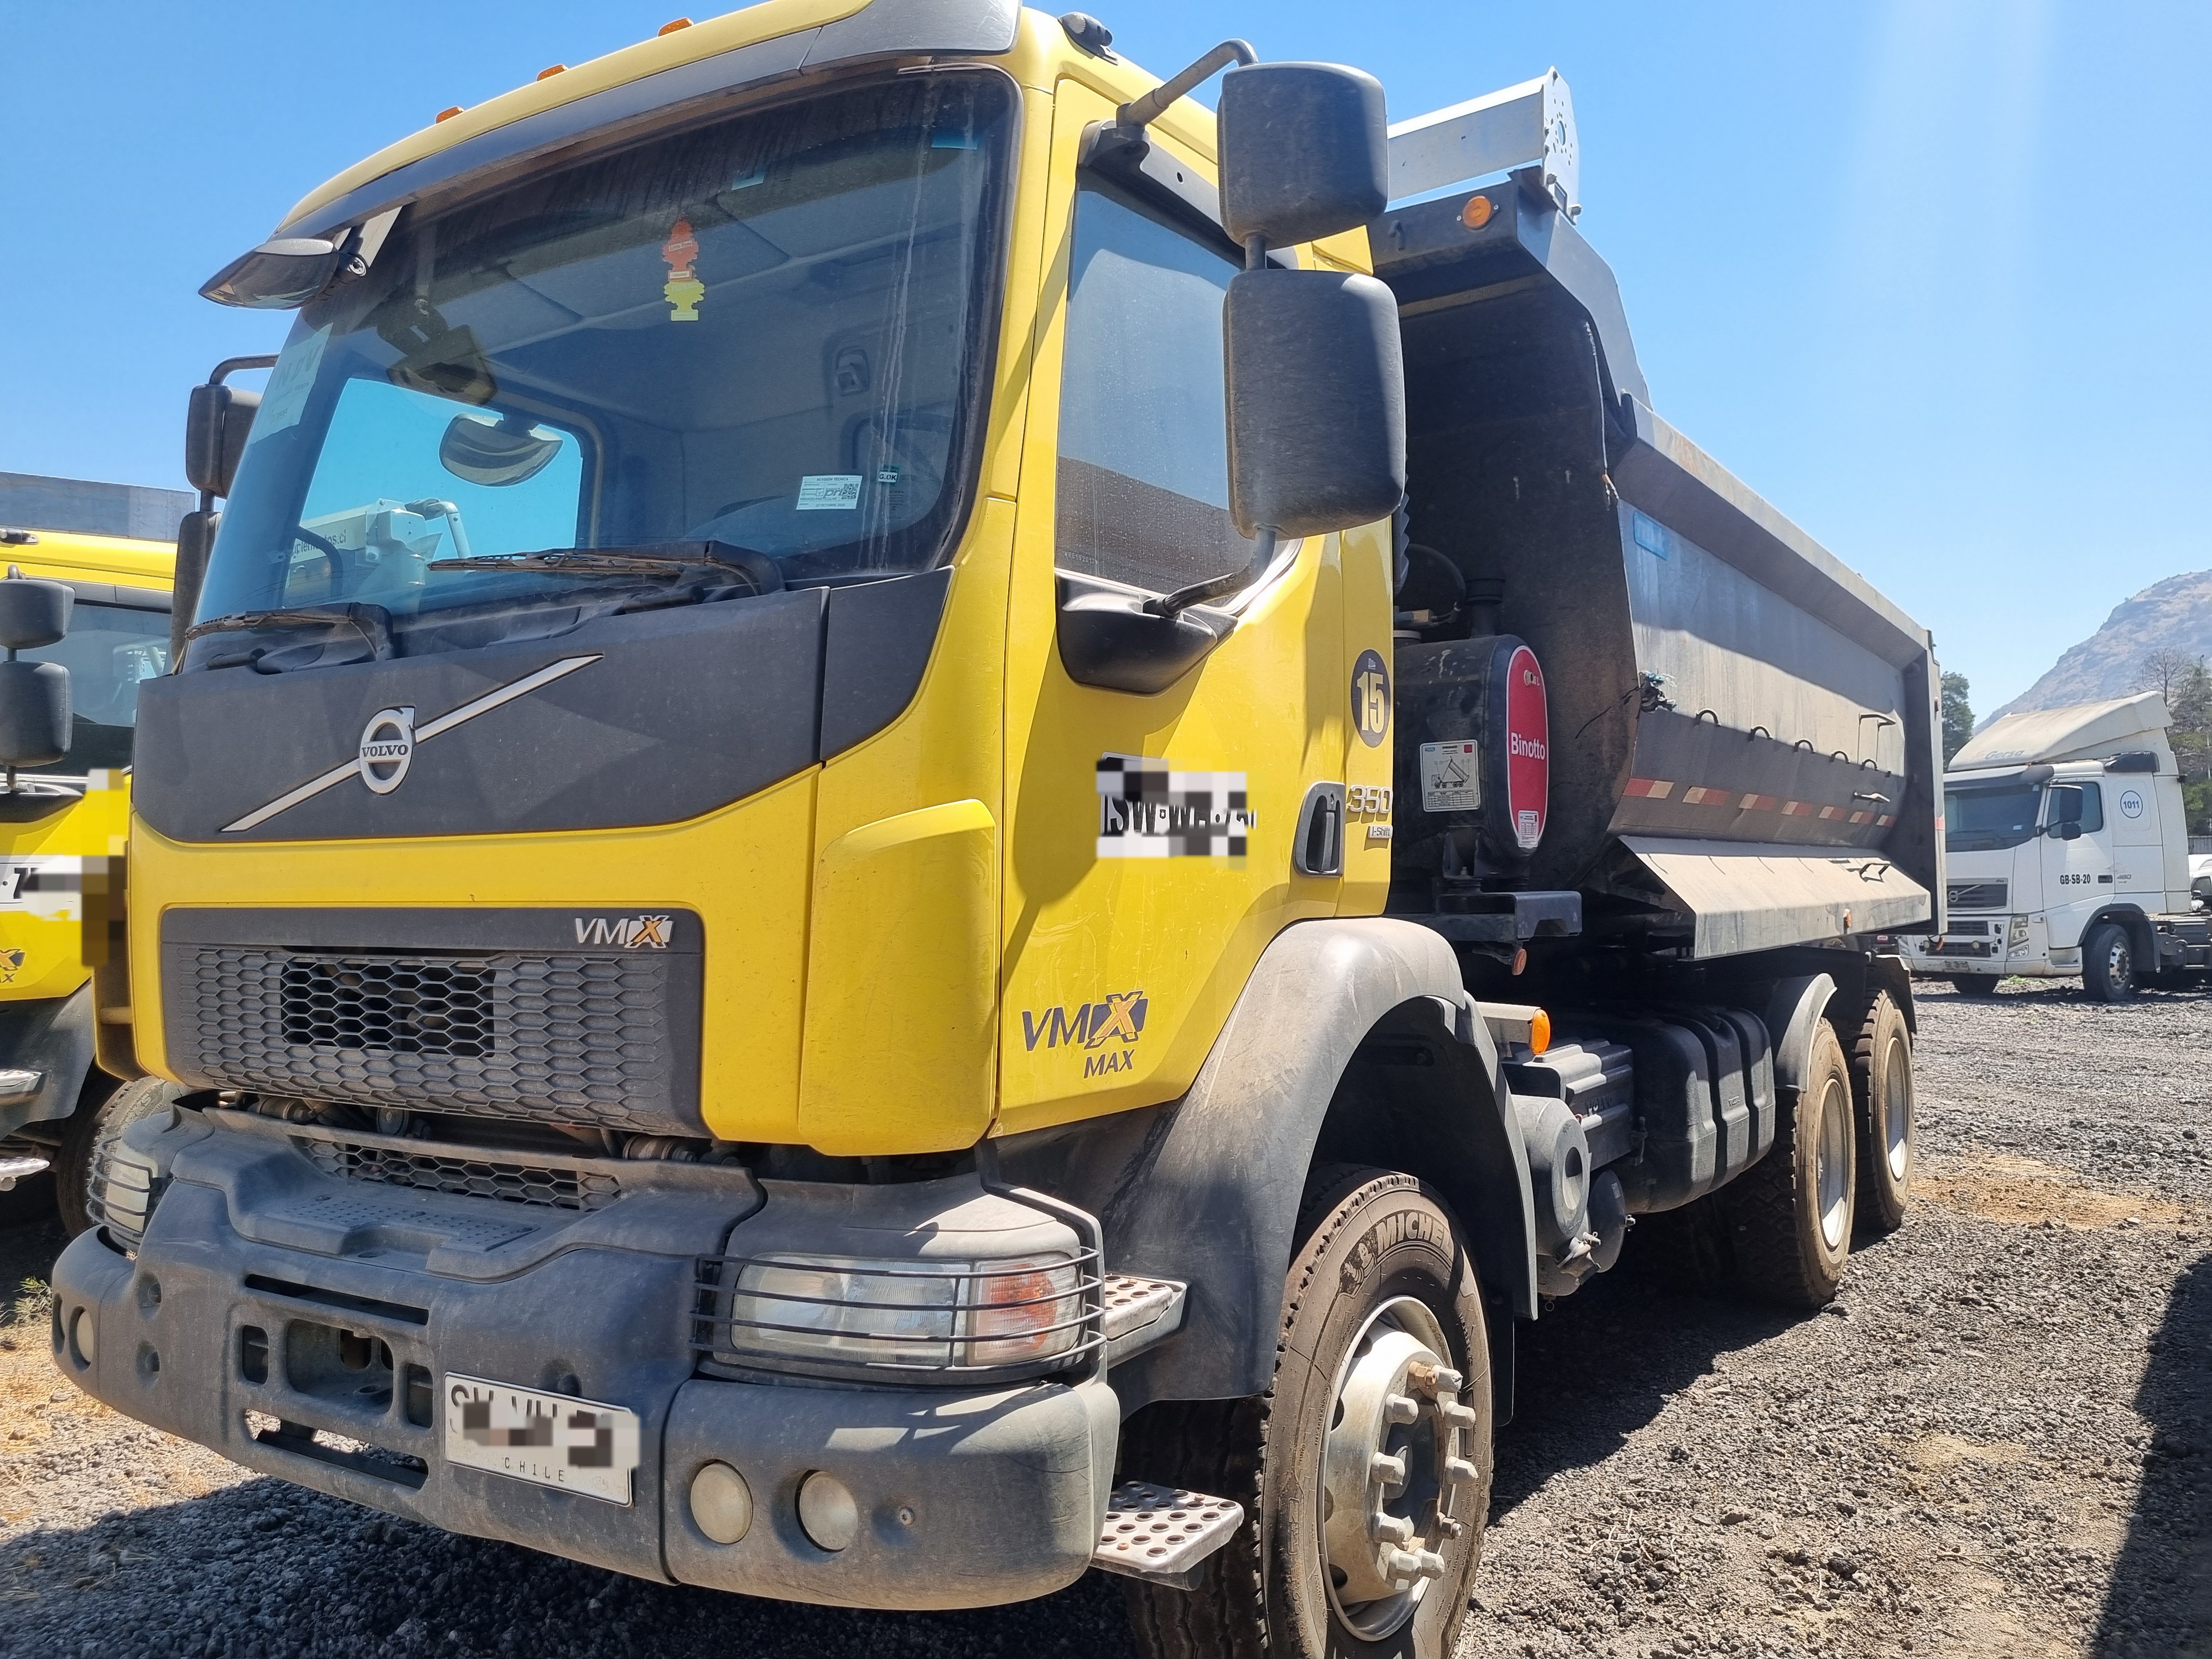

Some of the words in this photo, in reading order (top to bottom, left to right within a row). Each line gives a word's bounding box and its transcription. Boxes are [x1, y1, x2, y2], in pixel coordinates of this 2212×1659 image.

[1357, 671, 1385, 733] 15
[362, 744, 409, 757] VOLVO
[1511, 732, 1546, 760] Binotto
[1348, 784, 1393, 814] 350
[2123, 801, 2140, 809] 1011
[1371, 826, 1391, 836] I-Shift
[2059, 874, 2091, 885] GB-SB-20
[575, 915, 674, 948] VMX
[1022, 990, 1148, 1052] VMX
[1083, 1049, 1135, 1078] MAX
[1376, 1211, 1454, 1261] MICHEL
[504, 1457, 564, 1482] CHILE
